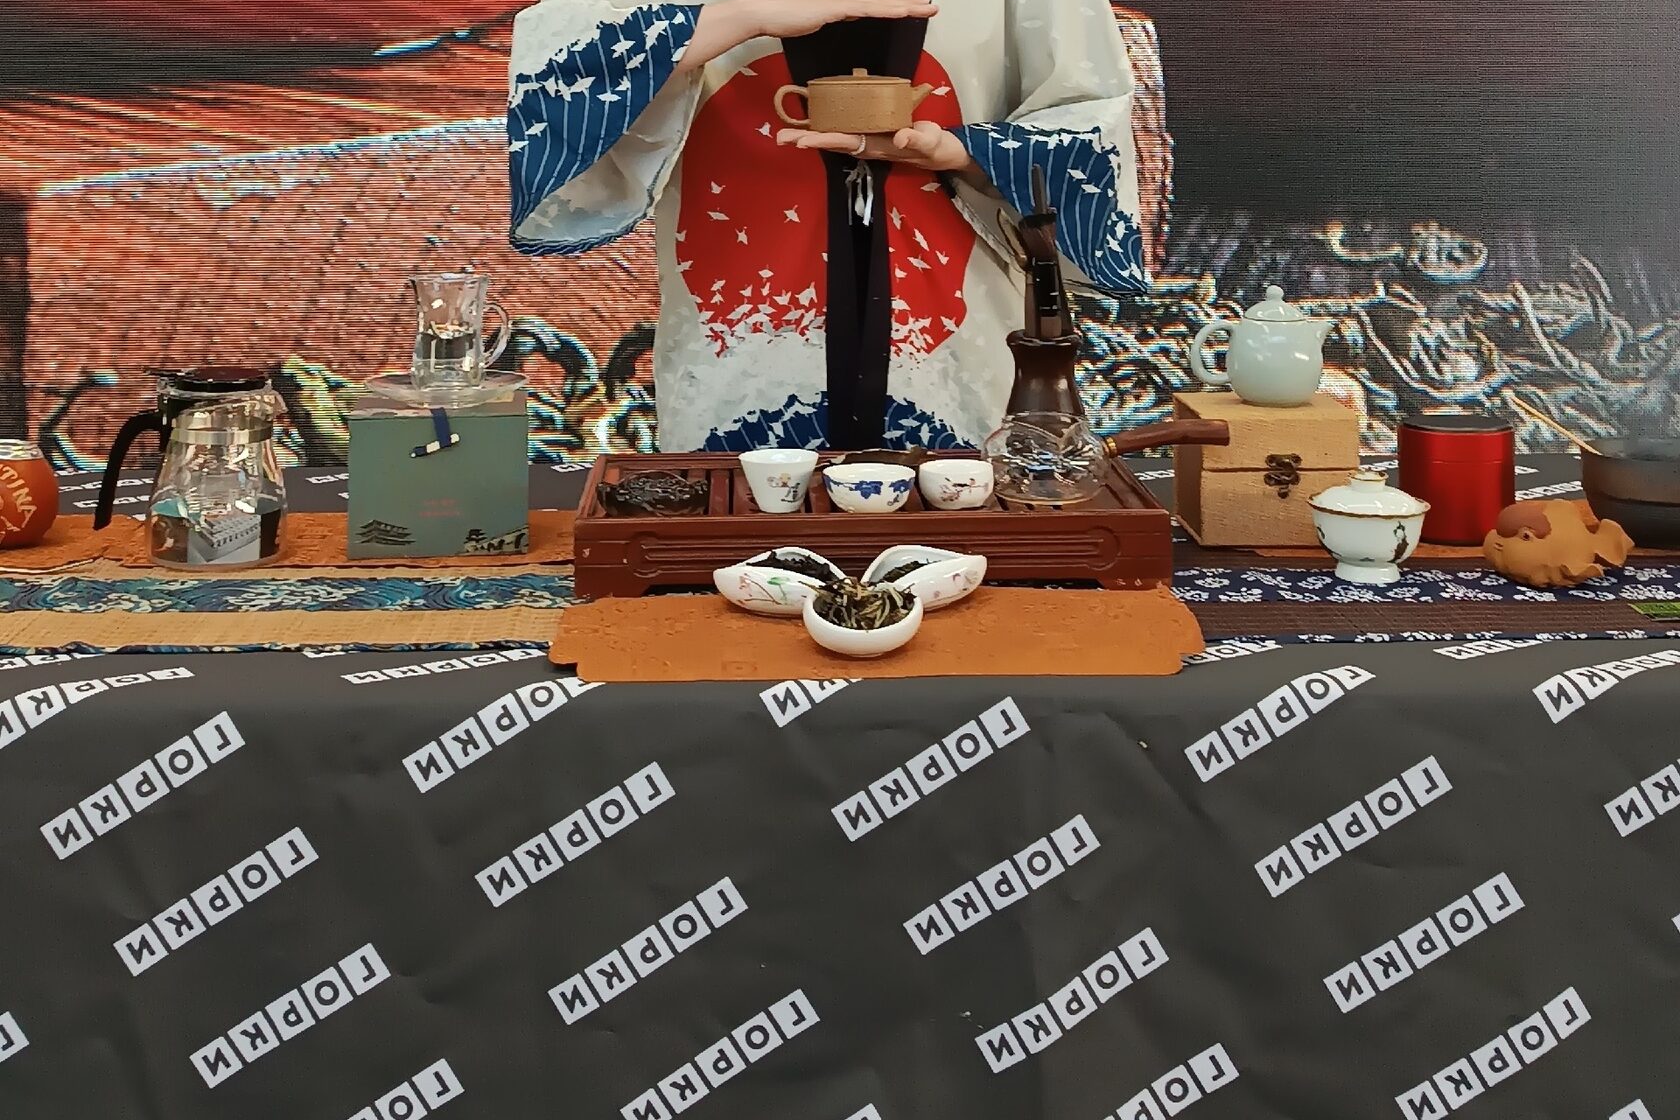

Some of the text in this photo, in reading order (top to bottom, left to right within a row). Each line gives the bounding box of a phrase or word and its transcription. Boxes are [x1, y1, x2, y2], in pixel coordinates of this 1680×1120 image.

[0, 463, 38, 529] TINA
[842, 708, 1017, 831] ГОРКИ
[1195, 666, 1363, 772] ГОРКИ
[51, 722, 233, 850] ГОРКИ
[486, 773, 662, 897] ГОРКИ
[1265, 767, 1440, 887] ГОРКИ
[125, 839, 306, 965] ГОРКИ
[914, 826, 1088, 944] ГОРКИ
[1335, 884, 1511, 1003] ГОРКИ
[558, 888, 734, 1014] ГОРКИ
[985, 939, 1156, 1063] ГОРКИ
[201, 954, 377, 1078] ГОРКИ
[1407, 998, 1579, 1120] ГОРКИ
[1128, 1053, 1228, 1120] ГОР
